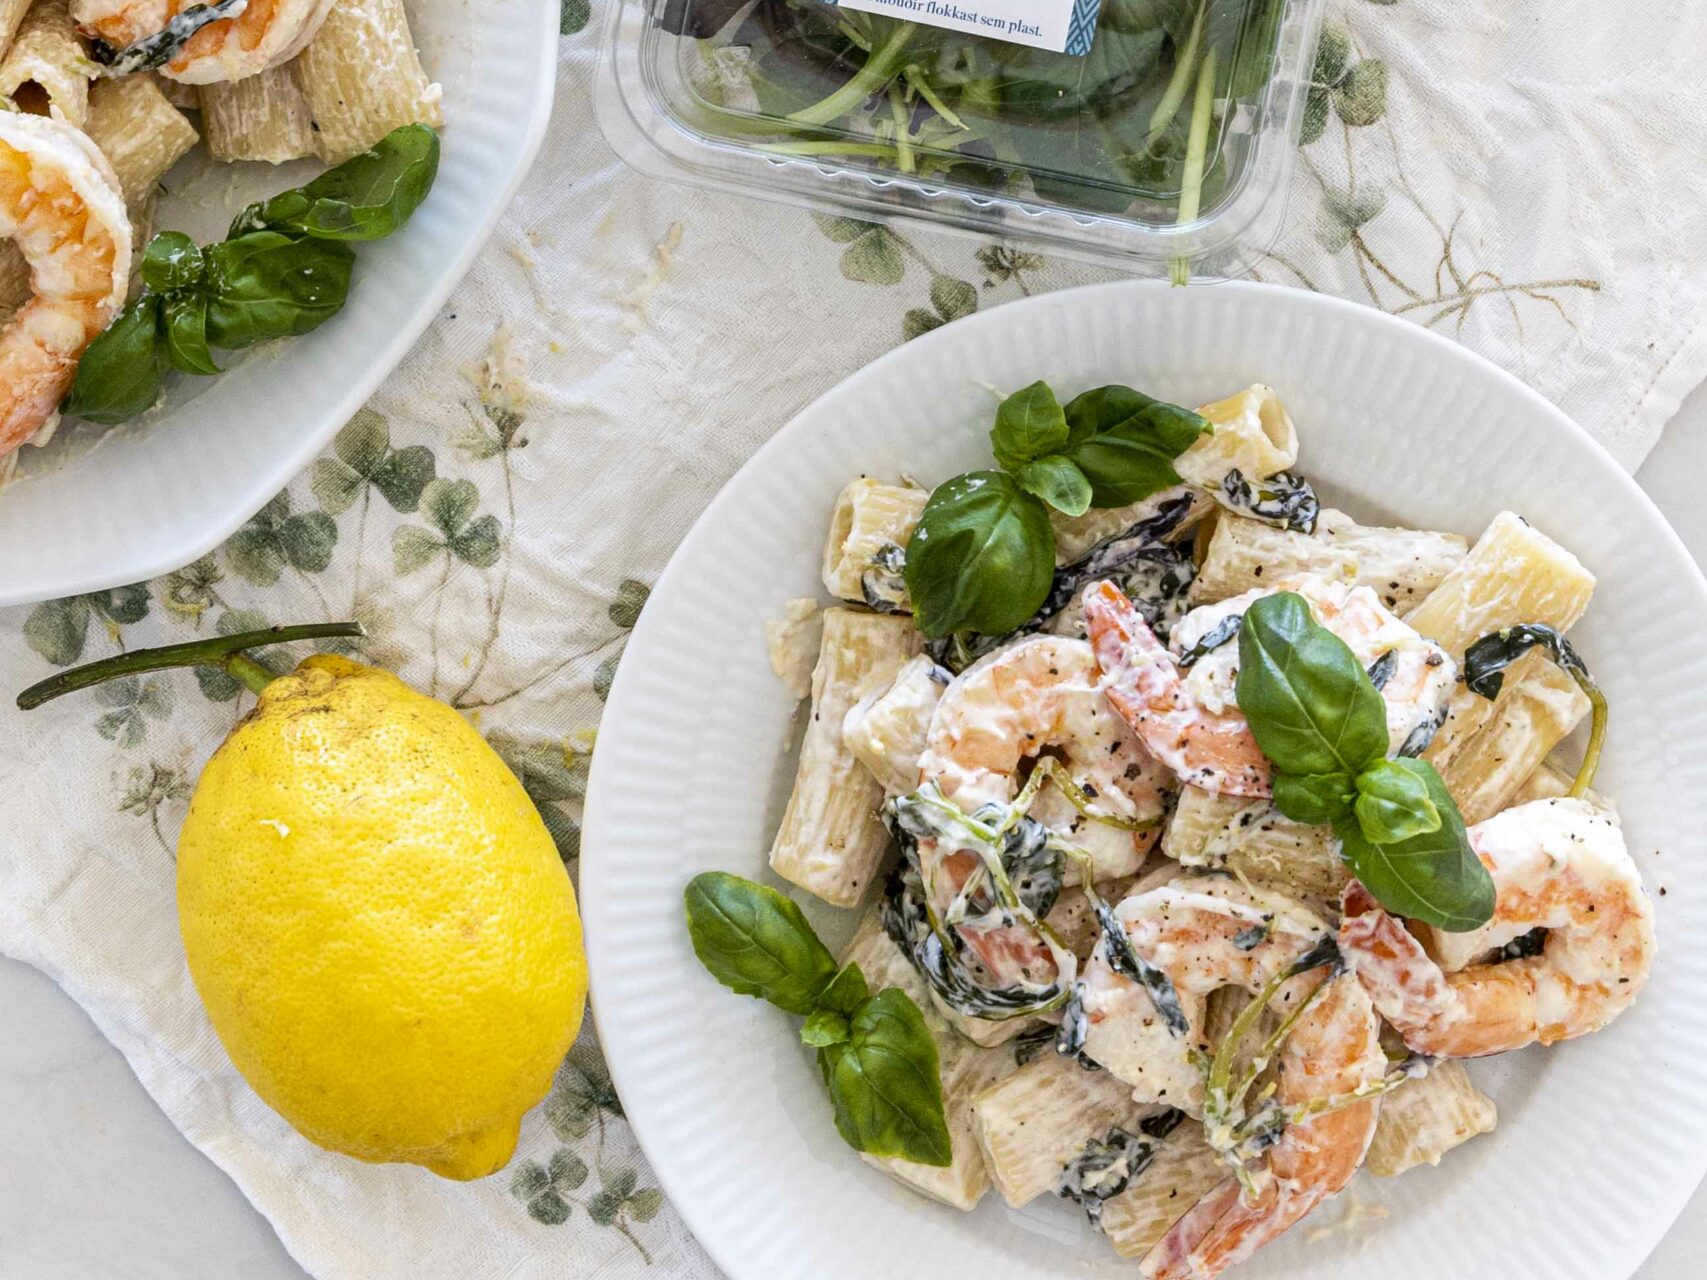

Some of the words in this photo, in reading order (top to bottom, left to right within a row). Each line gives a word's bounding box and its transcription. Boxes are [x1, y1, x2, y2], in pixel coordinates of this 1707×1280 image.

[926, 1, 978, 24] flokkast
[980, 15, 1006, 28] sem
[1007, 20, 1043, 38] plast.
